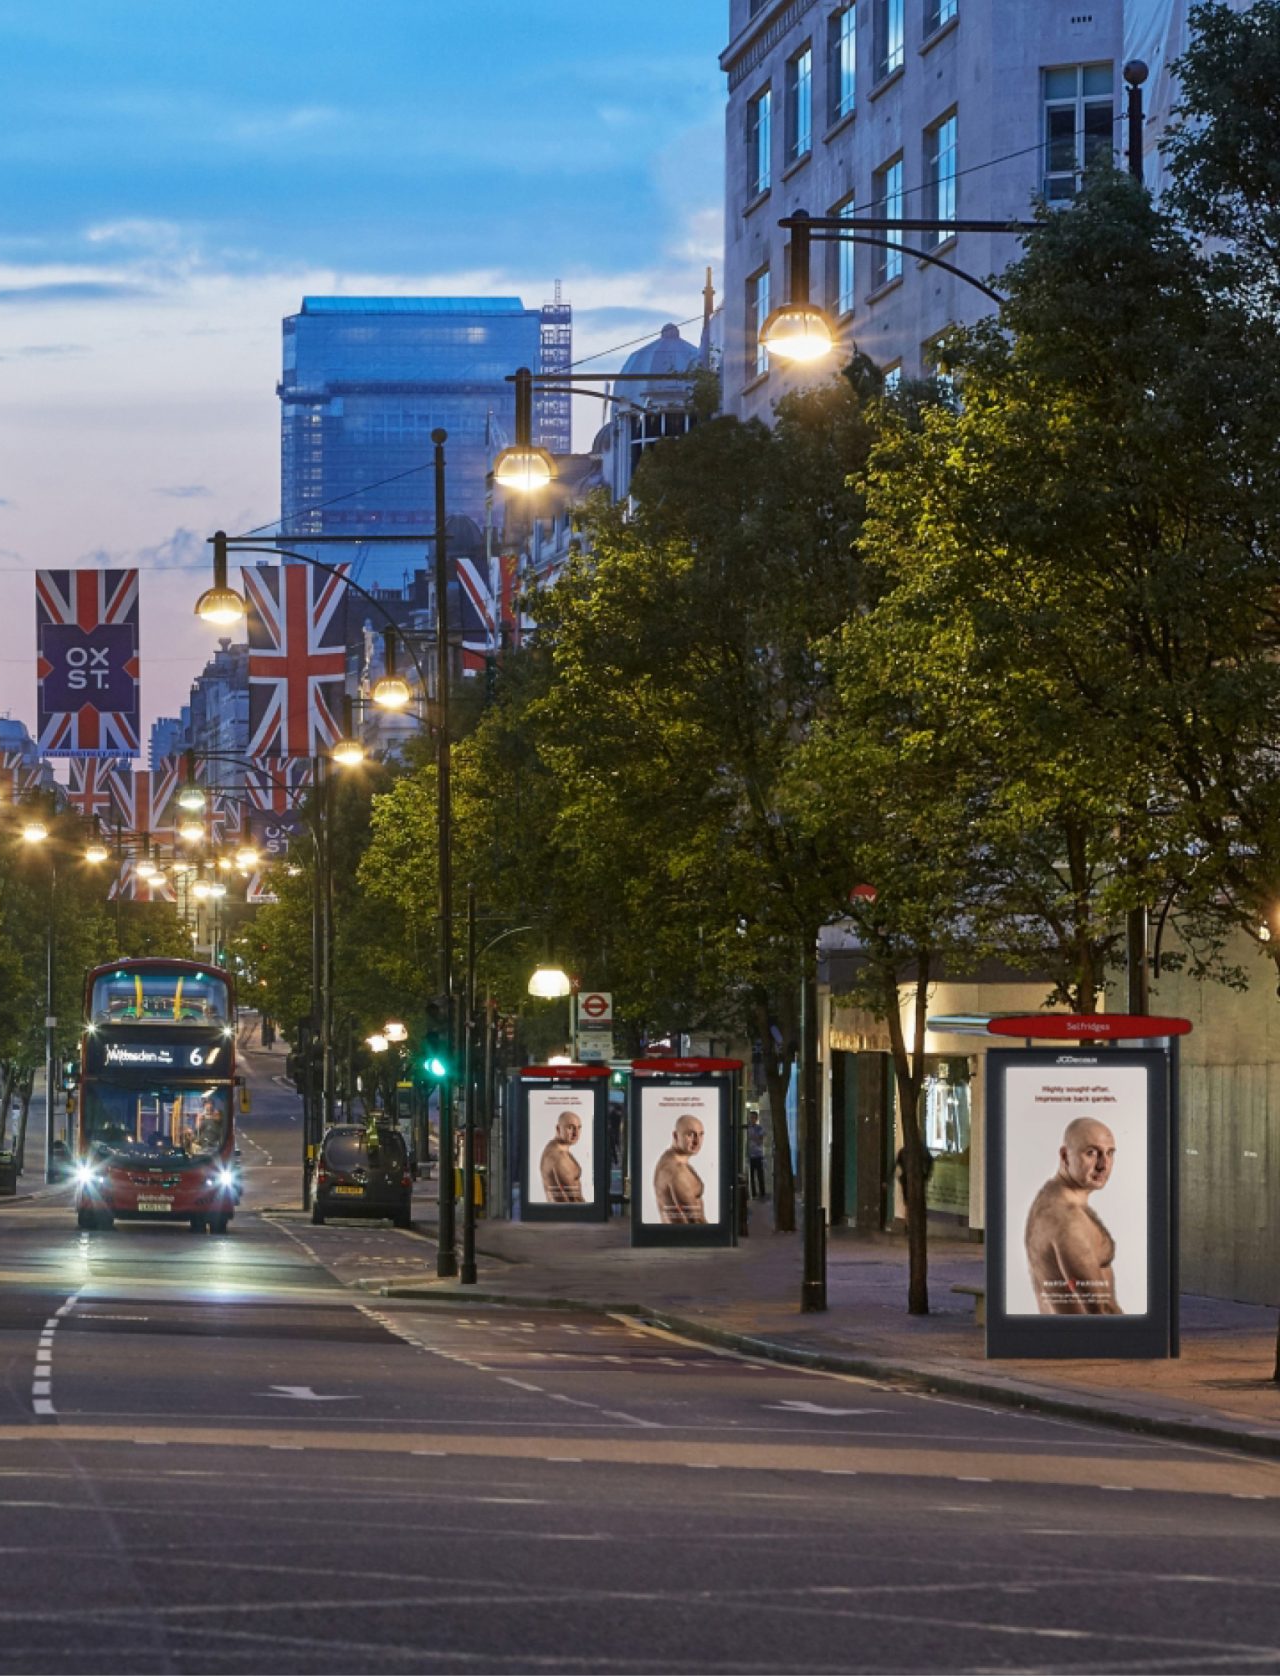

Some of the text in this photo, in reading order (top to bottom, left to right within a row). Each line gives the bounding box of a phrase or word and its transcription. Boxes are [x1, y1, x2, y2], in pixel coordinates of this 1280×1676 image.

[65, 647, 110, 667] OX
[67, 669, 110, 689] ST.
[1066, 1022, 1111, 1032] Selfridges
[1035, 1095, 1071, 1103] Impressive
